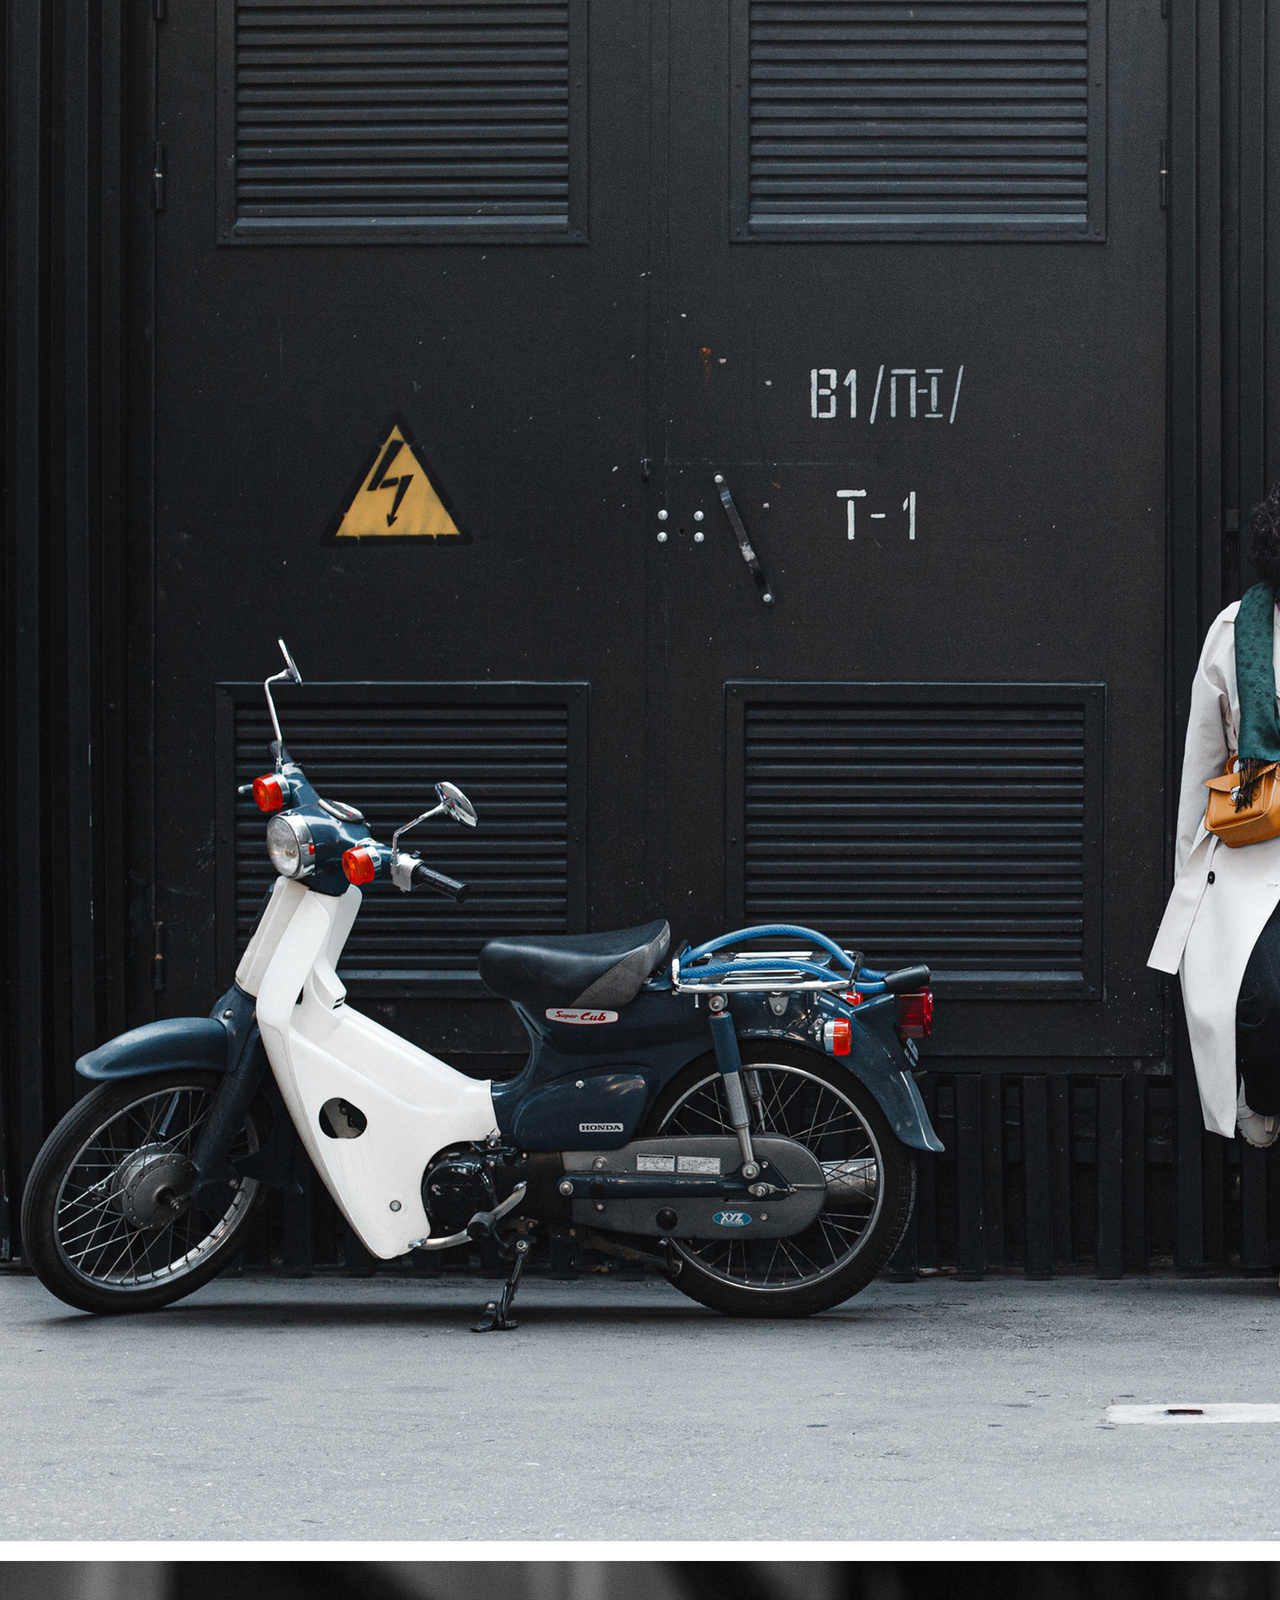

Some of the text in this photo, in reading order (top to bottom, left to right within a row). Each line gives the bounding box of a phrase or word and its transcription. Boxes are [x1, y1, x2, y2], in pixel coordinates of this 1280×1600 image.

[555, 1011, 606, 1021] Super Cub
[720, 1212, 743, 1222] XYZ
